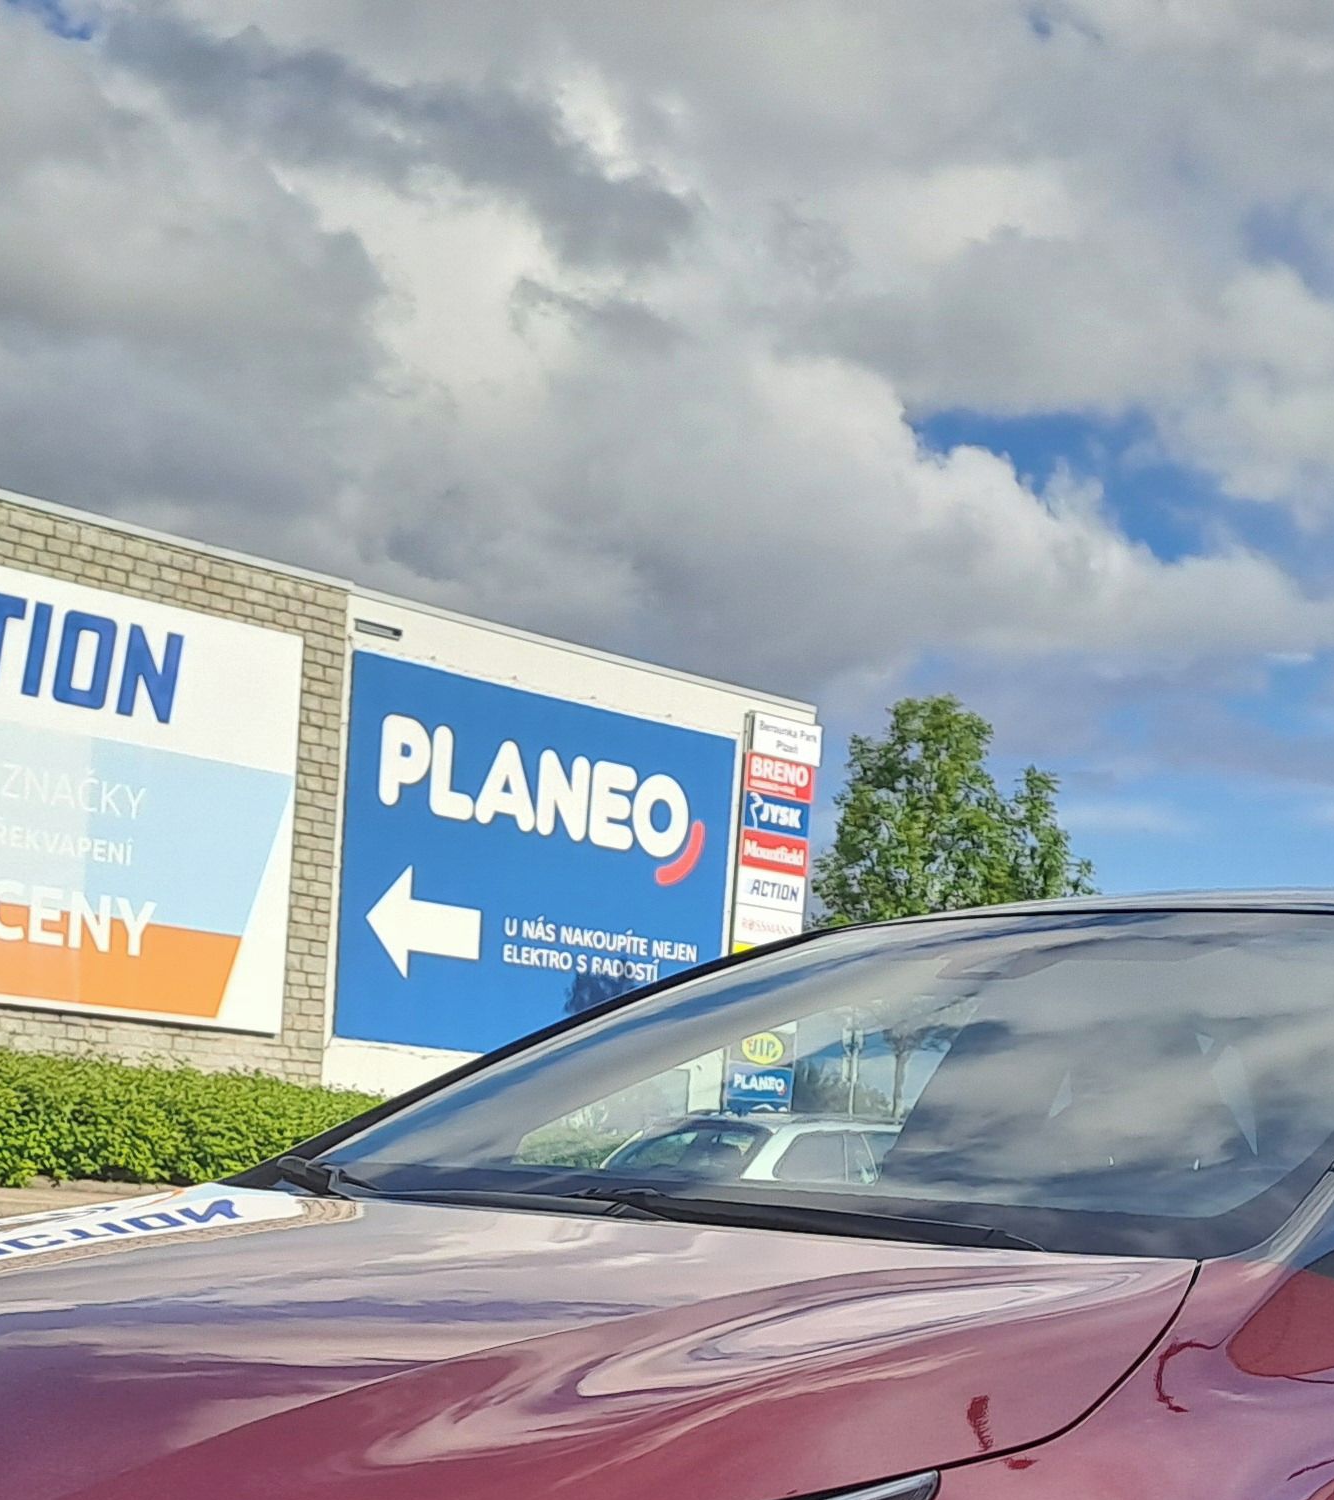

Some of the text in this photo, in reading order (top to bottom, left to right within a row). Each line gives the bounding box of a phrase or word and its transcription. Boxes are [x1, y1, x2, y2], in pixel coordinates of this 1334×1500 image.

[378, 714, 690, 860] PLANEO
[750, 754, 810, 788] BRENO
[2, 763, 148, 821] ZNAČKY
[760, 802, 802, 829] JYSK
[744, 838, 805, 867] Mountfield
[750, 878, 800, 902] ACTION
[504, 915, 698, 963] U NÁS NAKOUPÍTE NEJEN
[503, 943, 660, 983] ELEKTRO S RADOSTÍ
[732, 1073, 785, 1092] PLANEO
